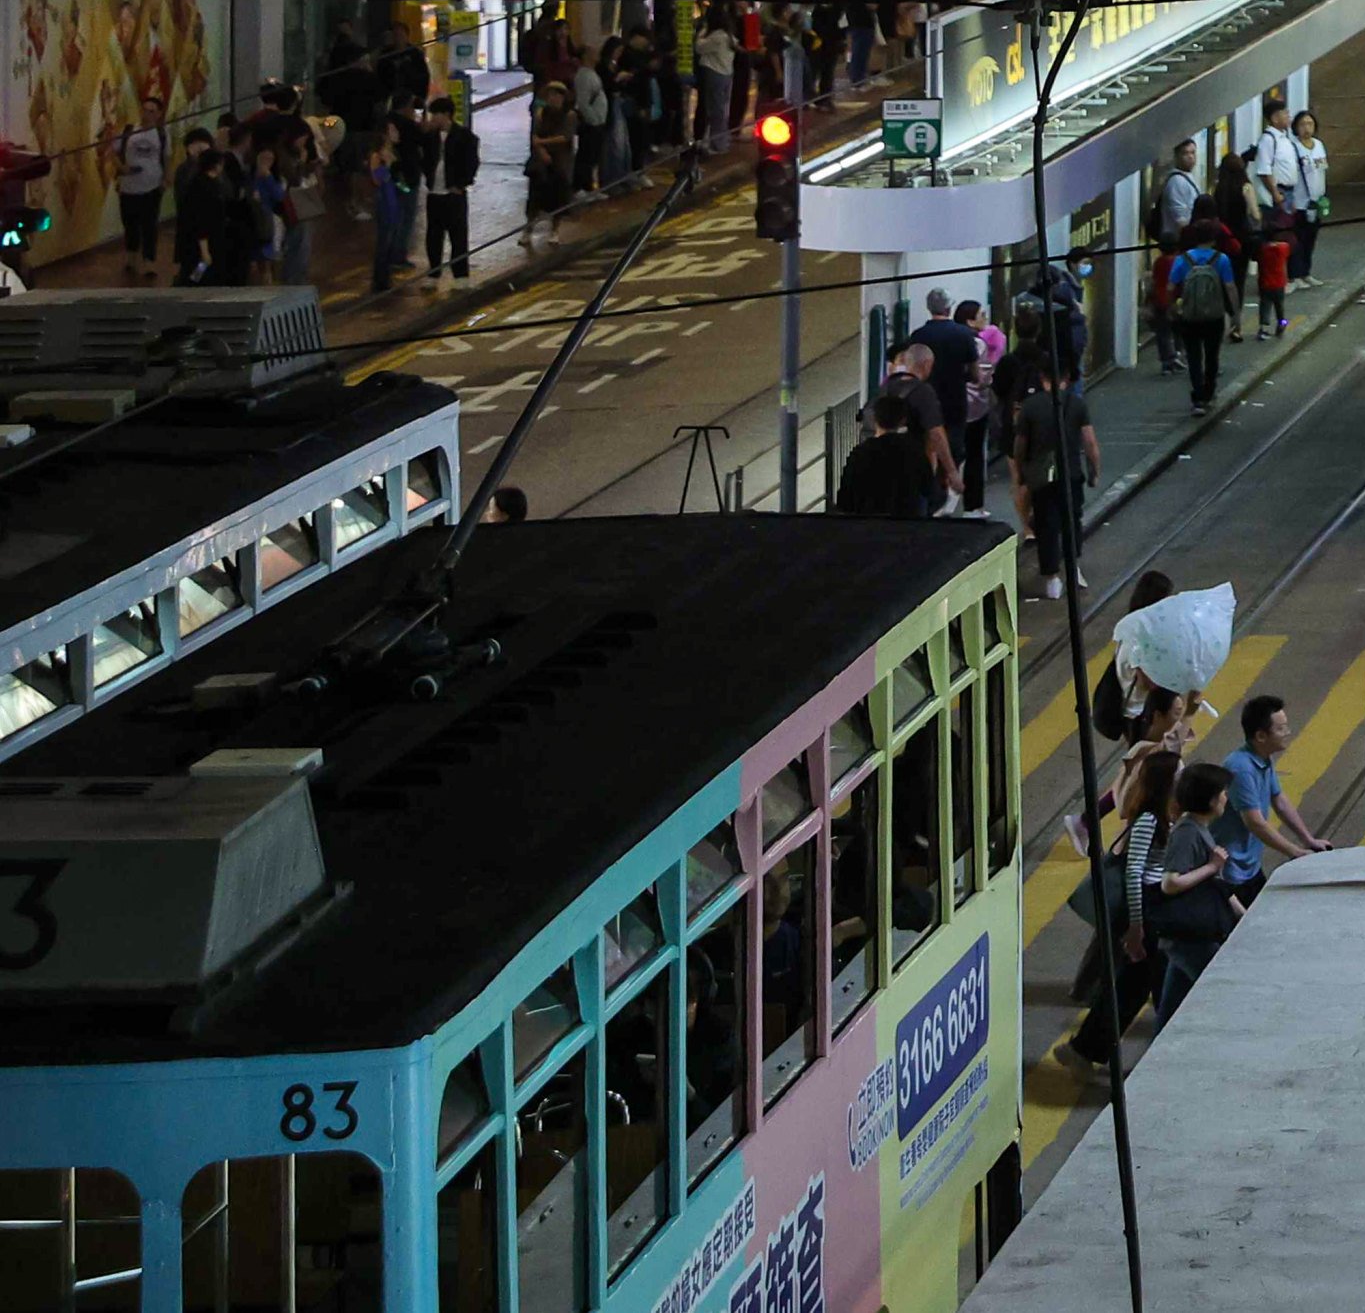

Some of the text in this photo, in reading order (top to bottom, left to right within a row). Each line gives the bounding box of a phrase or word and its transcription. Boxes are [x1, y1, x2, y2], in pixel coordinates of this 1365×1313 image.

[416, 320, 682, 356] STOP
[502, 293, 718, 323] BUS
[0, 858, 69, 970] 3
[901, 1005, 945, 1110] 3166
[948, 956, 986, 1057] 6631
[281, 1079, 358, 1141] 83
[857, 1108, 895, 1171] BOOK NOW
